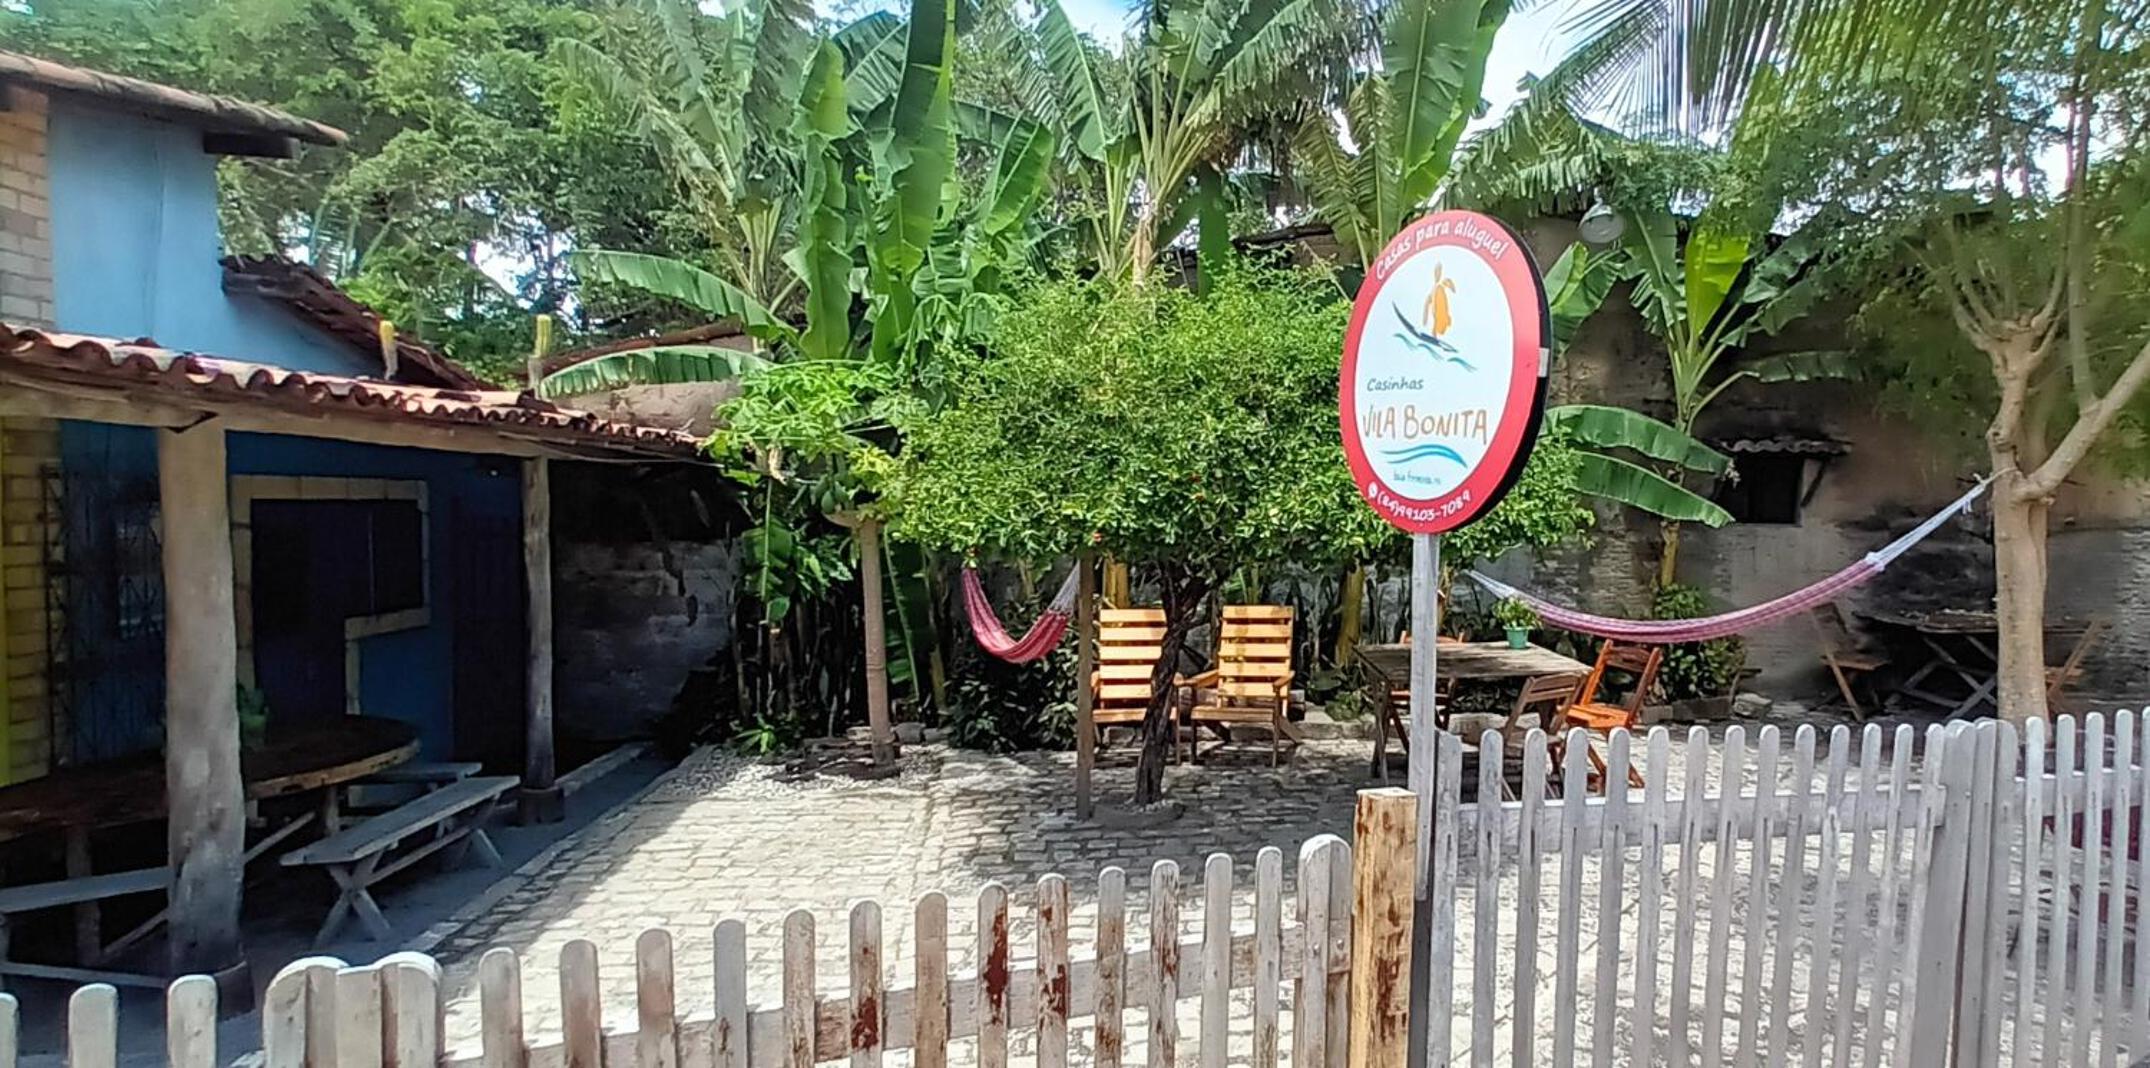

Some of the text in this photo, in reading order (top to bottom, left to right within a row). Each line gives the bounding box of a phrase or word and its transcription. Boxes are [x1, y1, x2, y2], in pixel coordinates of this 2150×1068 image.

[1376, 216, 1508, 279] Casas para aluguel
[1366, 376, 1424, 392] Casinhas
[1362, 404, 1488, 446] VILA BONITA
